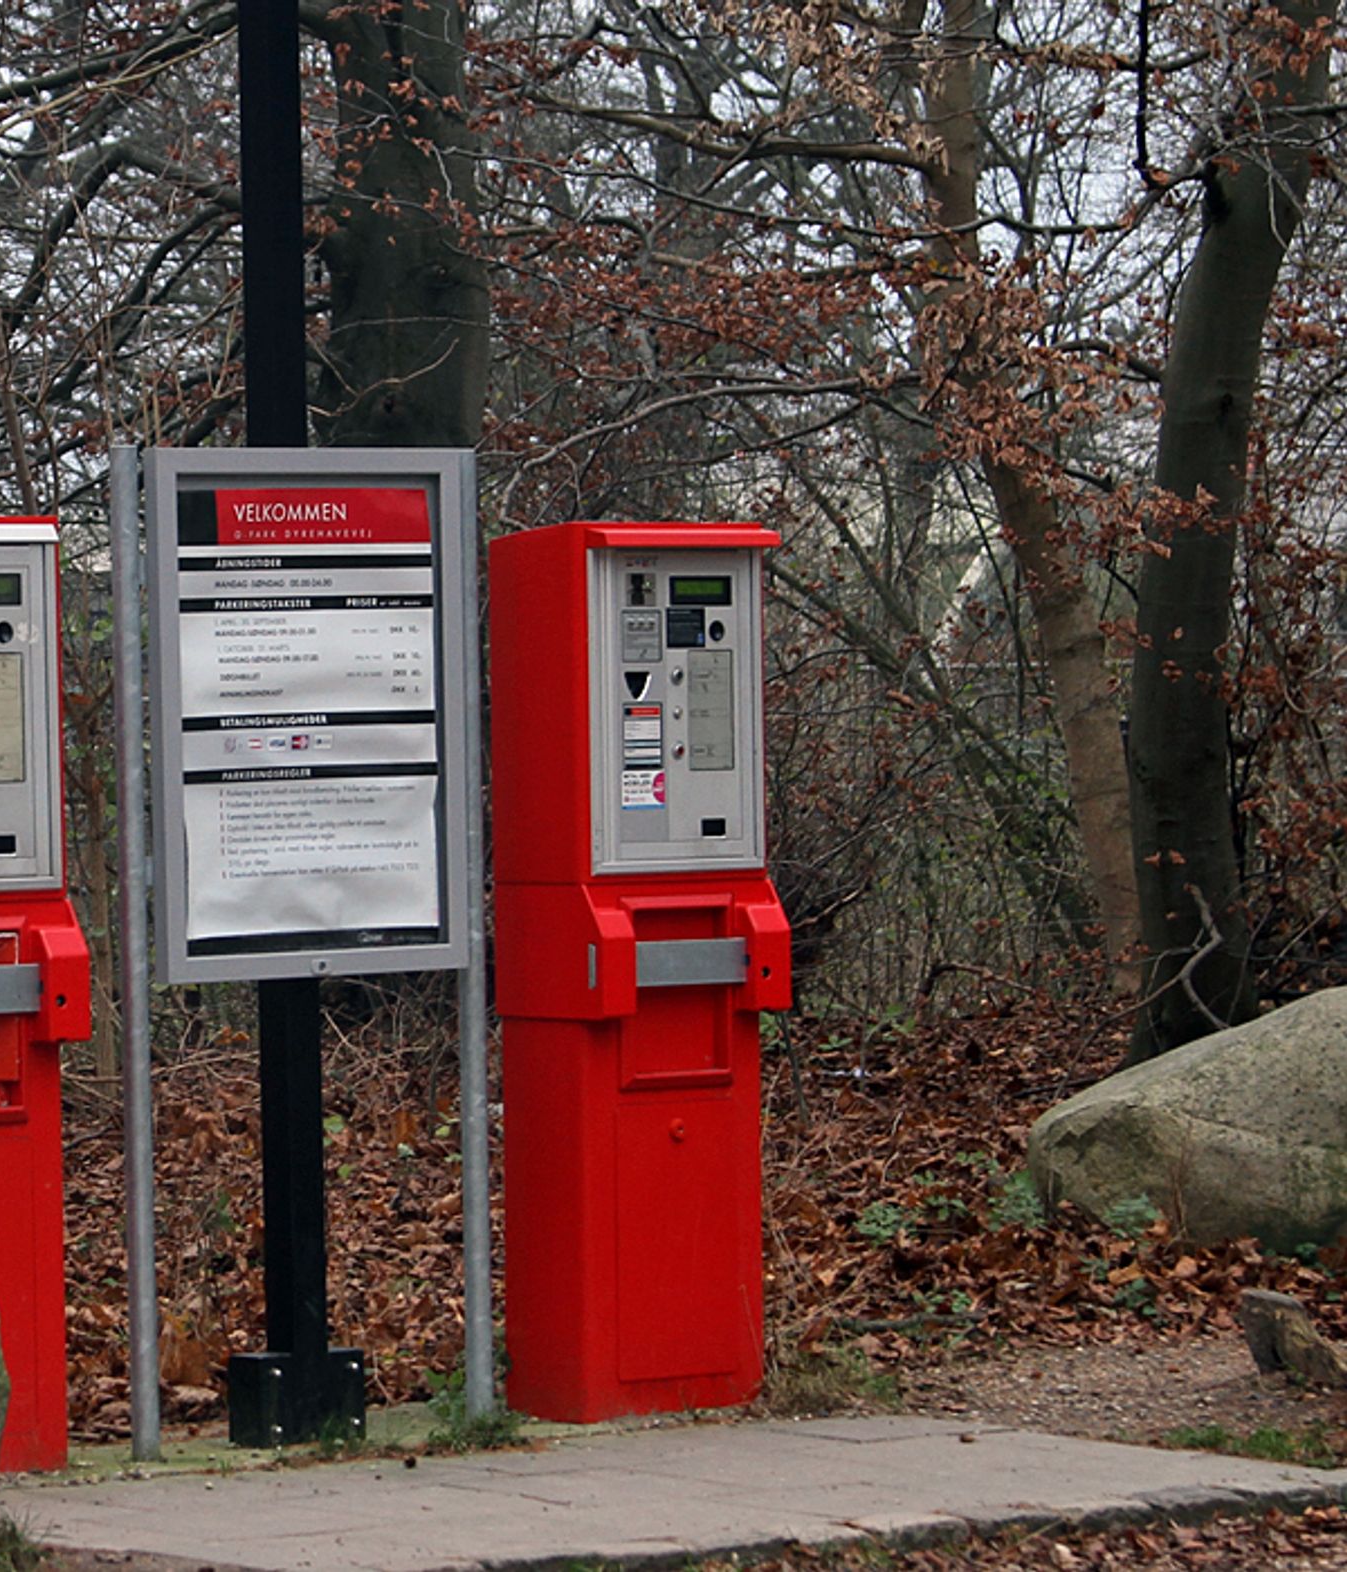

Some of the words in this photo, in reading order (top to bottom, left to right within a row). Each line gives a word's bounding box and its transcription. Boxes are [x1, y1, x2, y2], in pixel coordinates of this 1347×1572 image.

[233, 503, 347, 522] VELKOMMEN
[284, 528, 372, 539] DYREHAVEVEJ
[214, 557, 282, 569] ÅBNINGSTIDER
[214, 599, 312, 610] PARKERINGSTAKSTER
[345, 597, 378, 607] PRISER
[219, 714, 328, 728] BETALINGSMULIGHEDER
[221, 768, 312, 782] PARKERINGSREGLER
